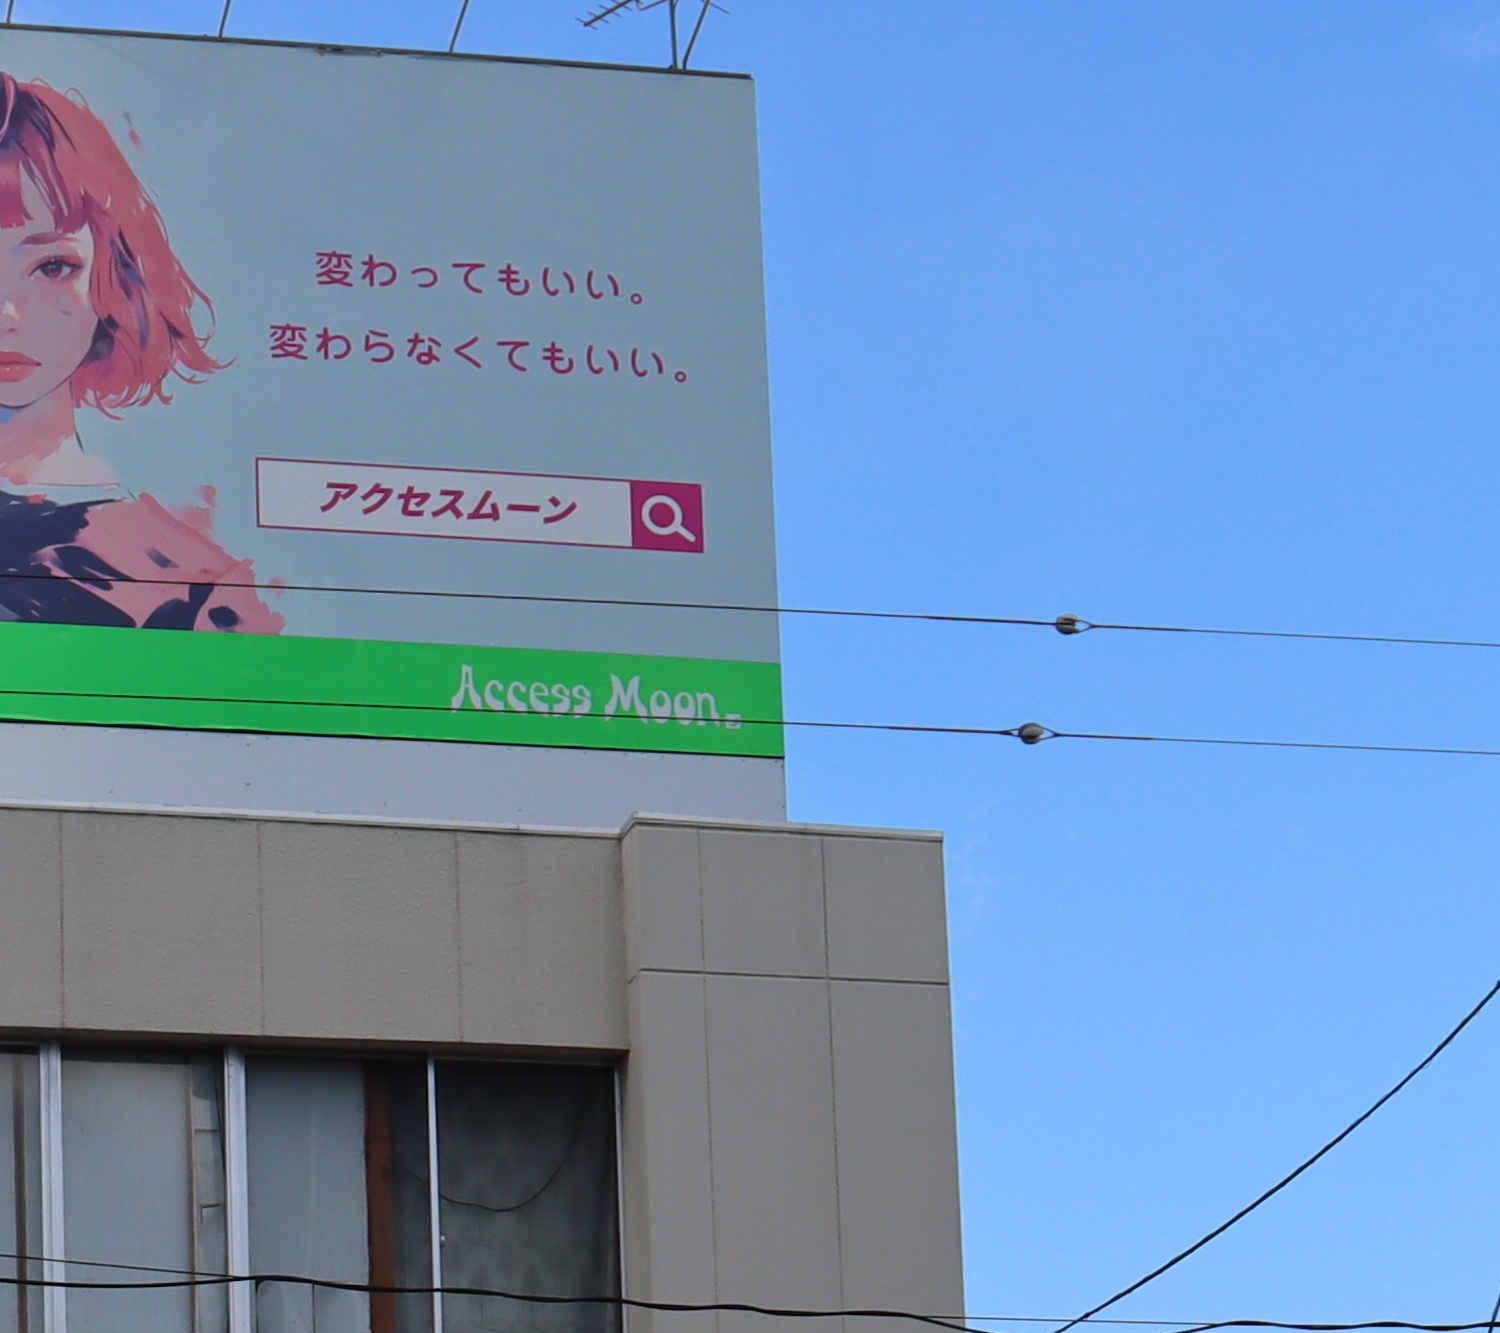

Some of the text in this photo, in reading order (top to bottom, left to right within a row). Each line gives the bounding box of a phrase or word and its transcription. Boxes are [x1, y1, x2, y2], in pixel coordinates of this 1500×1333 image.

[315, 250, 643, 305] 変わってもいい。
[269, 323, 687, 383] 変わらなくてもいい。
[319, 480, 578, 524] アクセスムーン
[450, 663, 593, 719] Access
